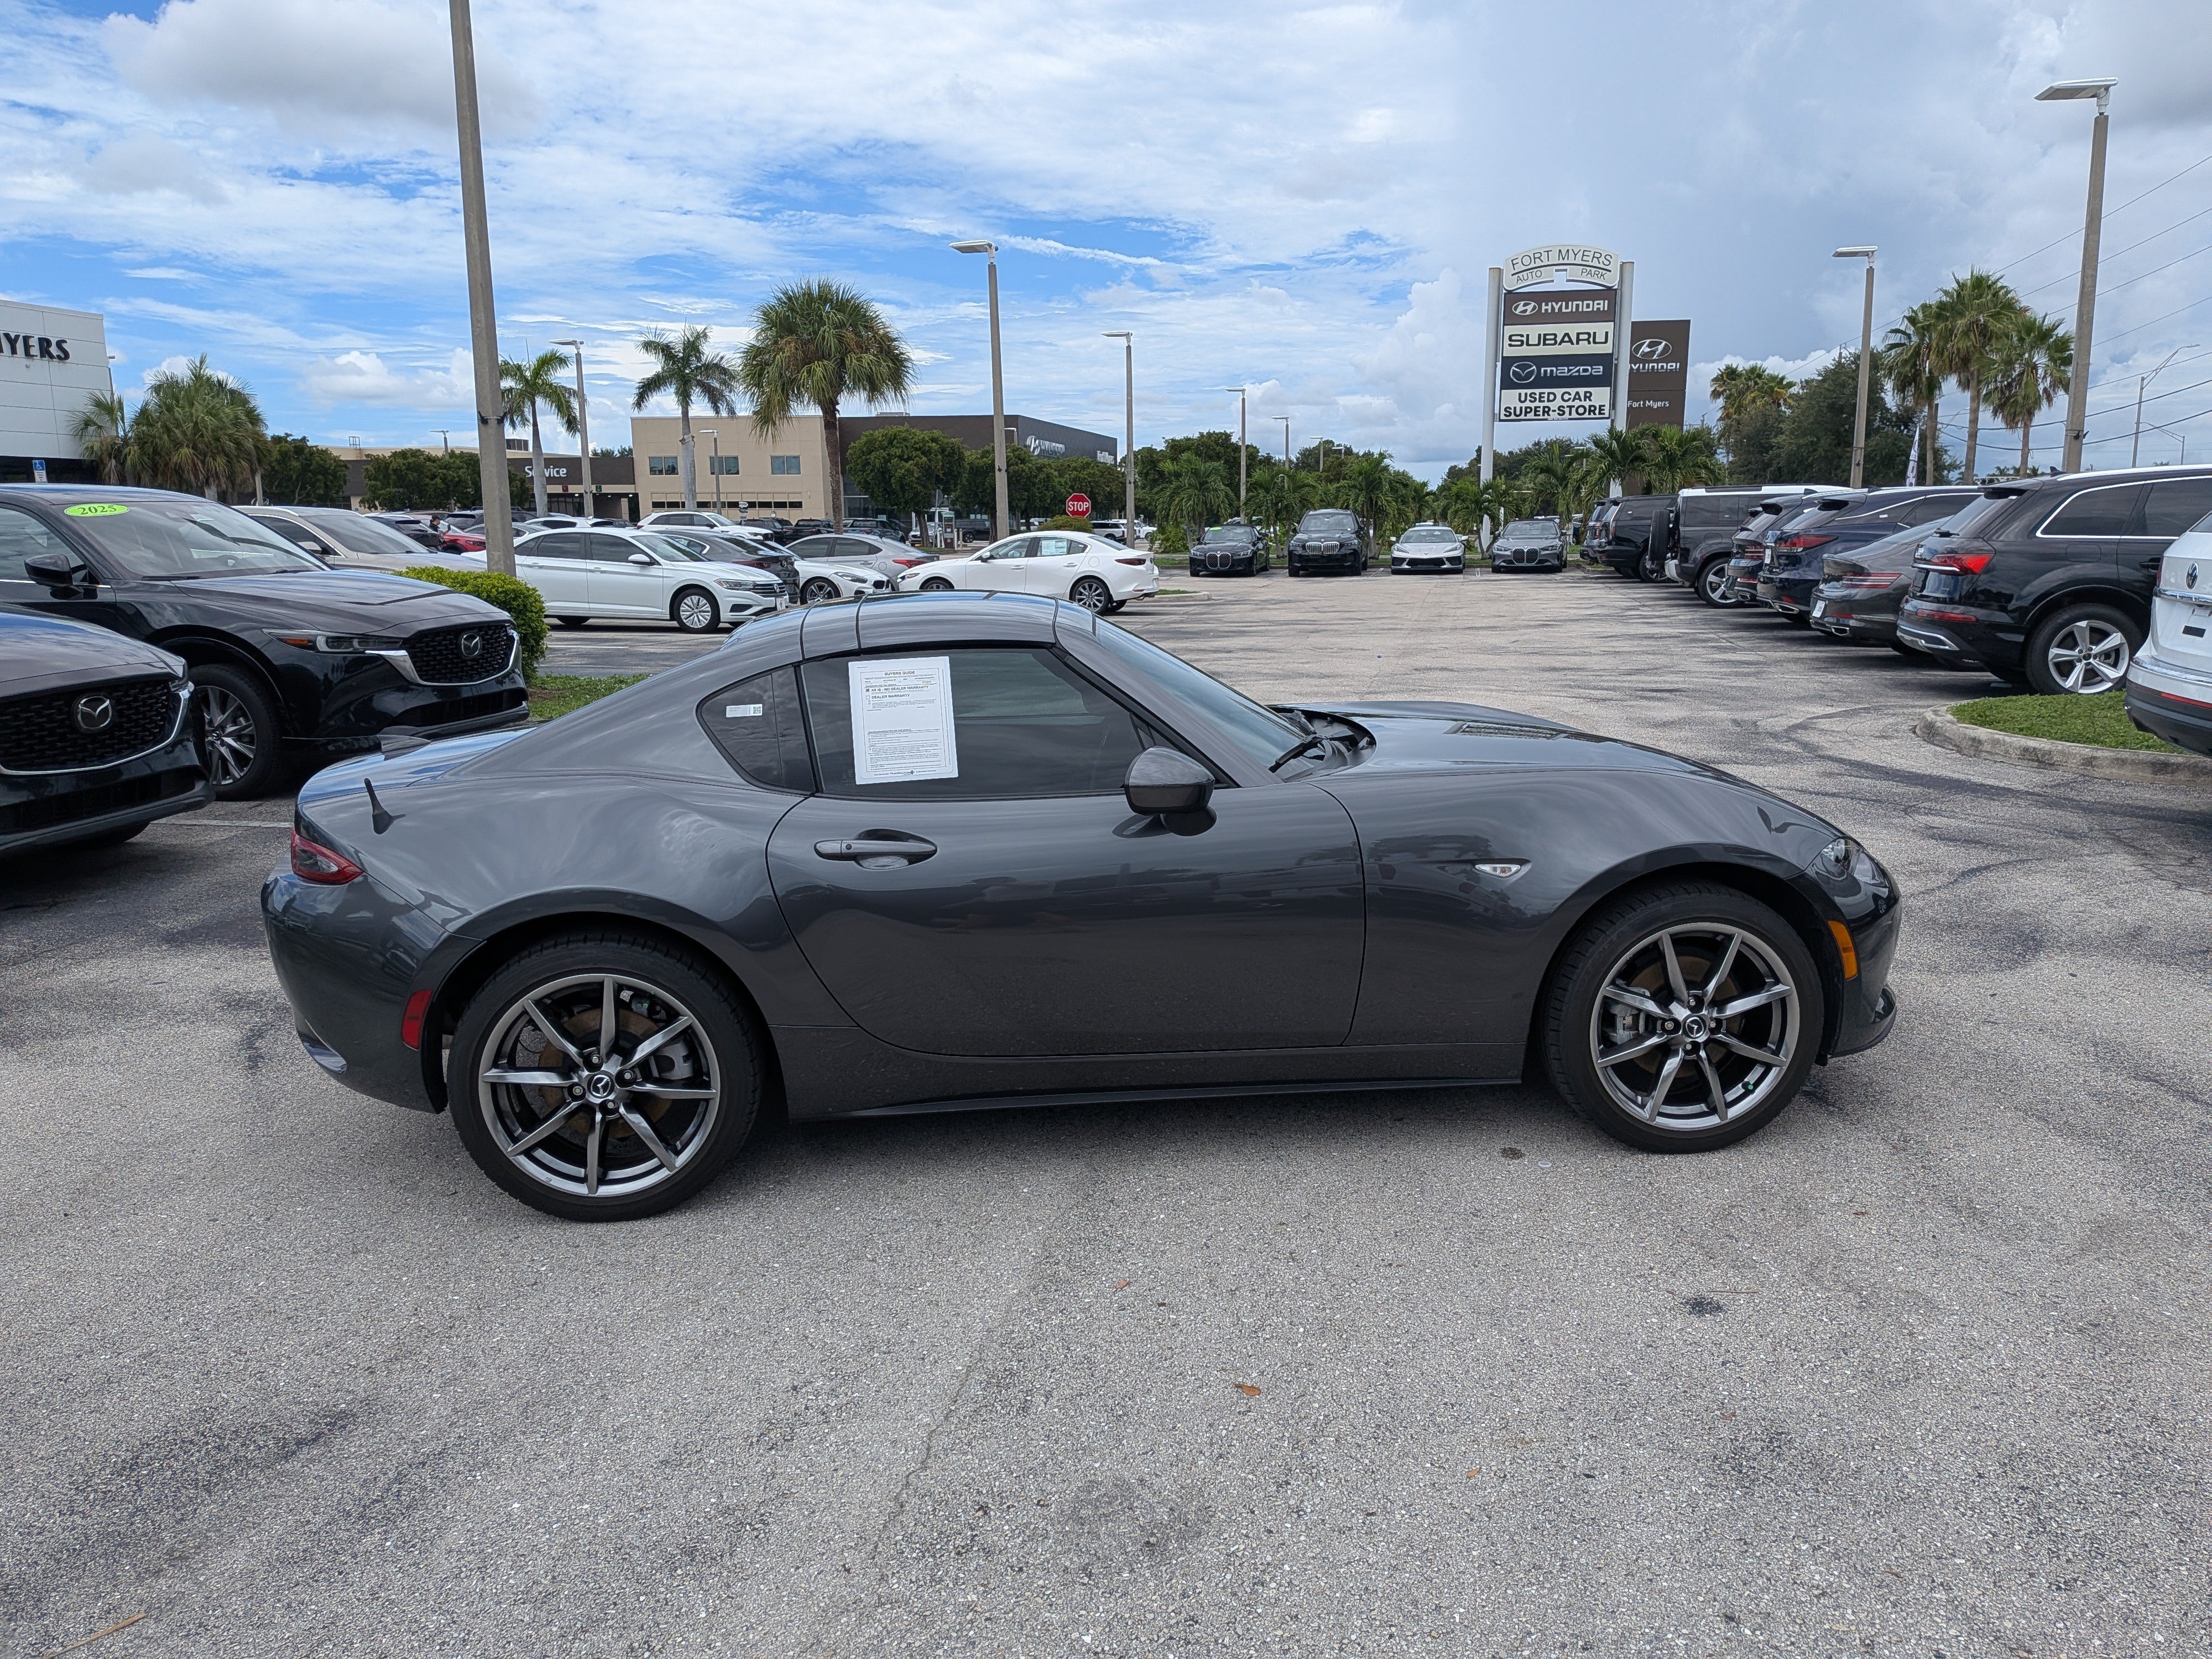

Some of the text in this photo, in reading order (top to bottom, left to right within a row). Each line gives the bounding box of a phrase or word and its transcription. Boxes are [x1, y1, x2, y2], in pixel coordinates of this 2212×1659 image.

[1511, 249, 1613, 271] FORT MYERS
[1516, 268, 1607, 284] AUTO PARK
[1541, 300, 1608, 313] HYUNDAI
[1507, 331, 1609, 347] SUBARU
[0, 333, 70, 361] YERS
[1541, 366, 1603, 377] mazda
[1629, 362, 1680, 372] YUNDAI
[1518, 390, 1593, 403] USED CAR
[1503, 404, 1606, 418] SUPER-STORE
[1645, 400, 1669, 409] Myers
[525, 466, 567, 477] Svice
[77, 505, 117, 515] 2025
[1068, 501, 1089, 512] STOP
